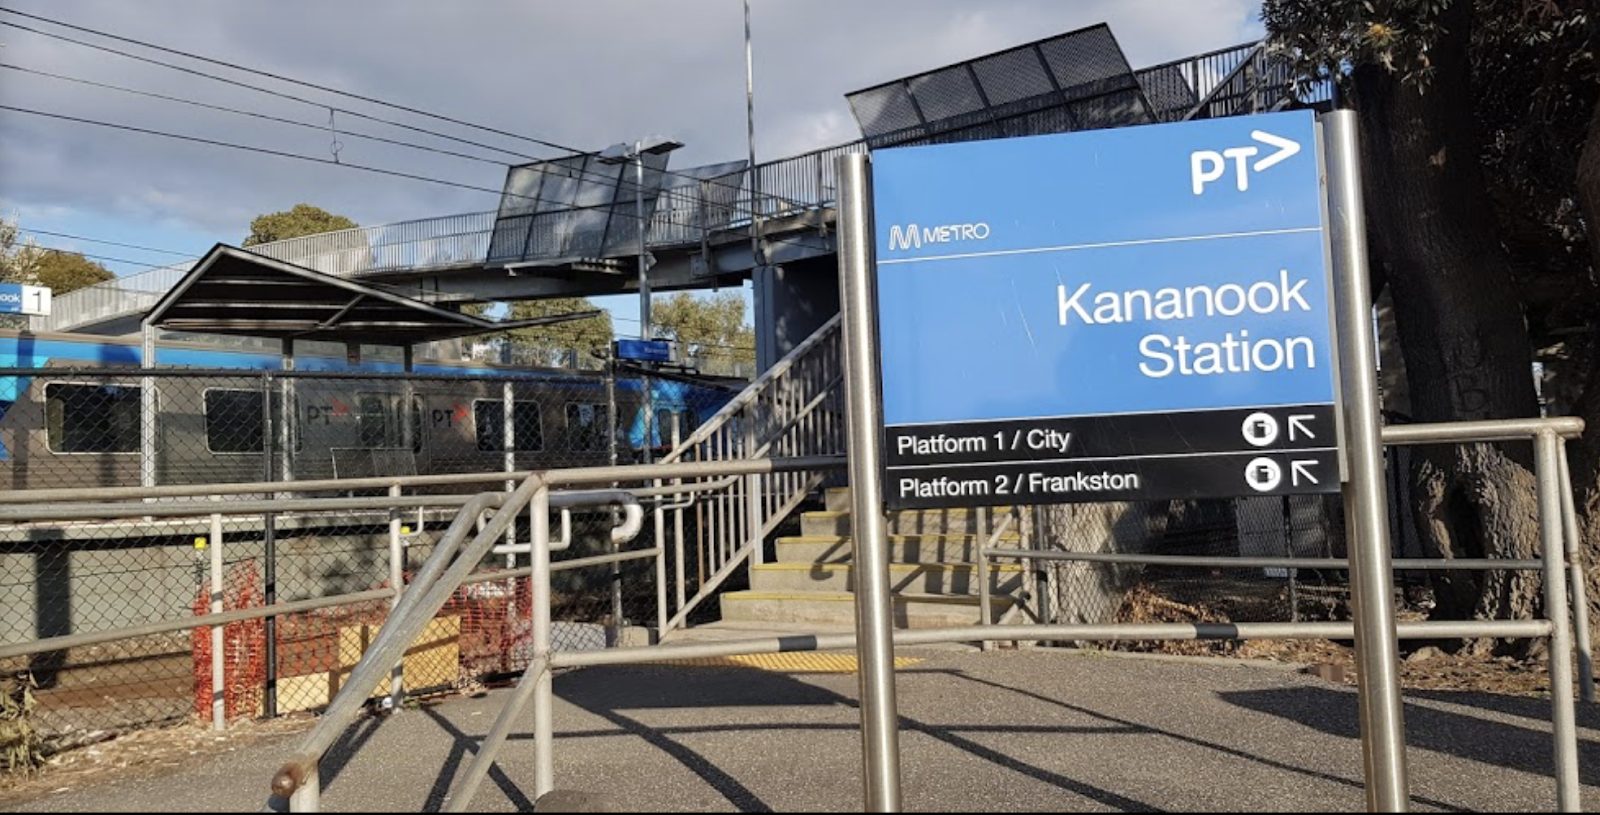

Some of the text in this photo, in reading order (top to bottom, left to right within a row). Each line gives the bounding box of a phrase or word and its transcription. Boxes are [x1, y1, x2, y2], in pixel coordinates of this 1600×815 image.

[923, 223, 990, 243] METRO
[32, 290, 42, 312] 1
[1057, 269, 1311, 326] Kananook
[1138, 329, 1316, 378] Station
[898, 434, 986, 455] Platform
[993, 431, 1004, 450] 1
[1027, 428, 1071, 452] City
[900, 477, 988, 498] Platform
[995, 475, 1008, 494] 2
[1028, 471, 1139, 493] Frankston
